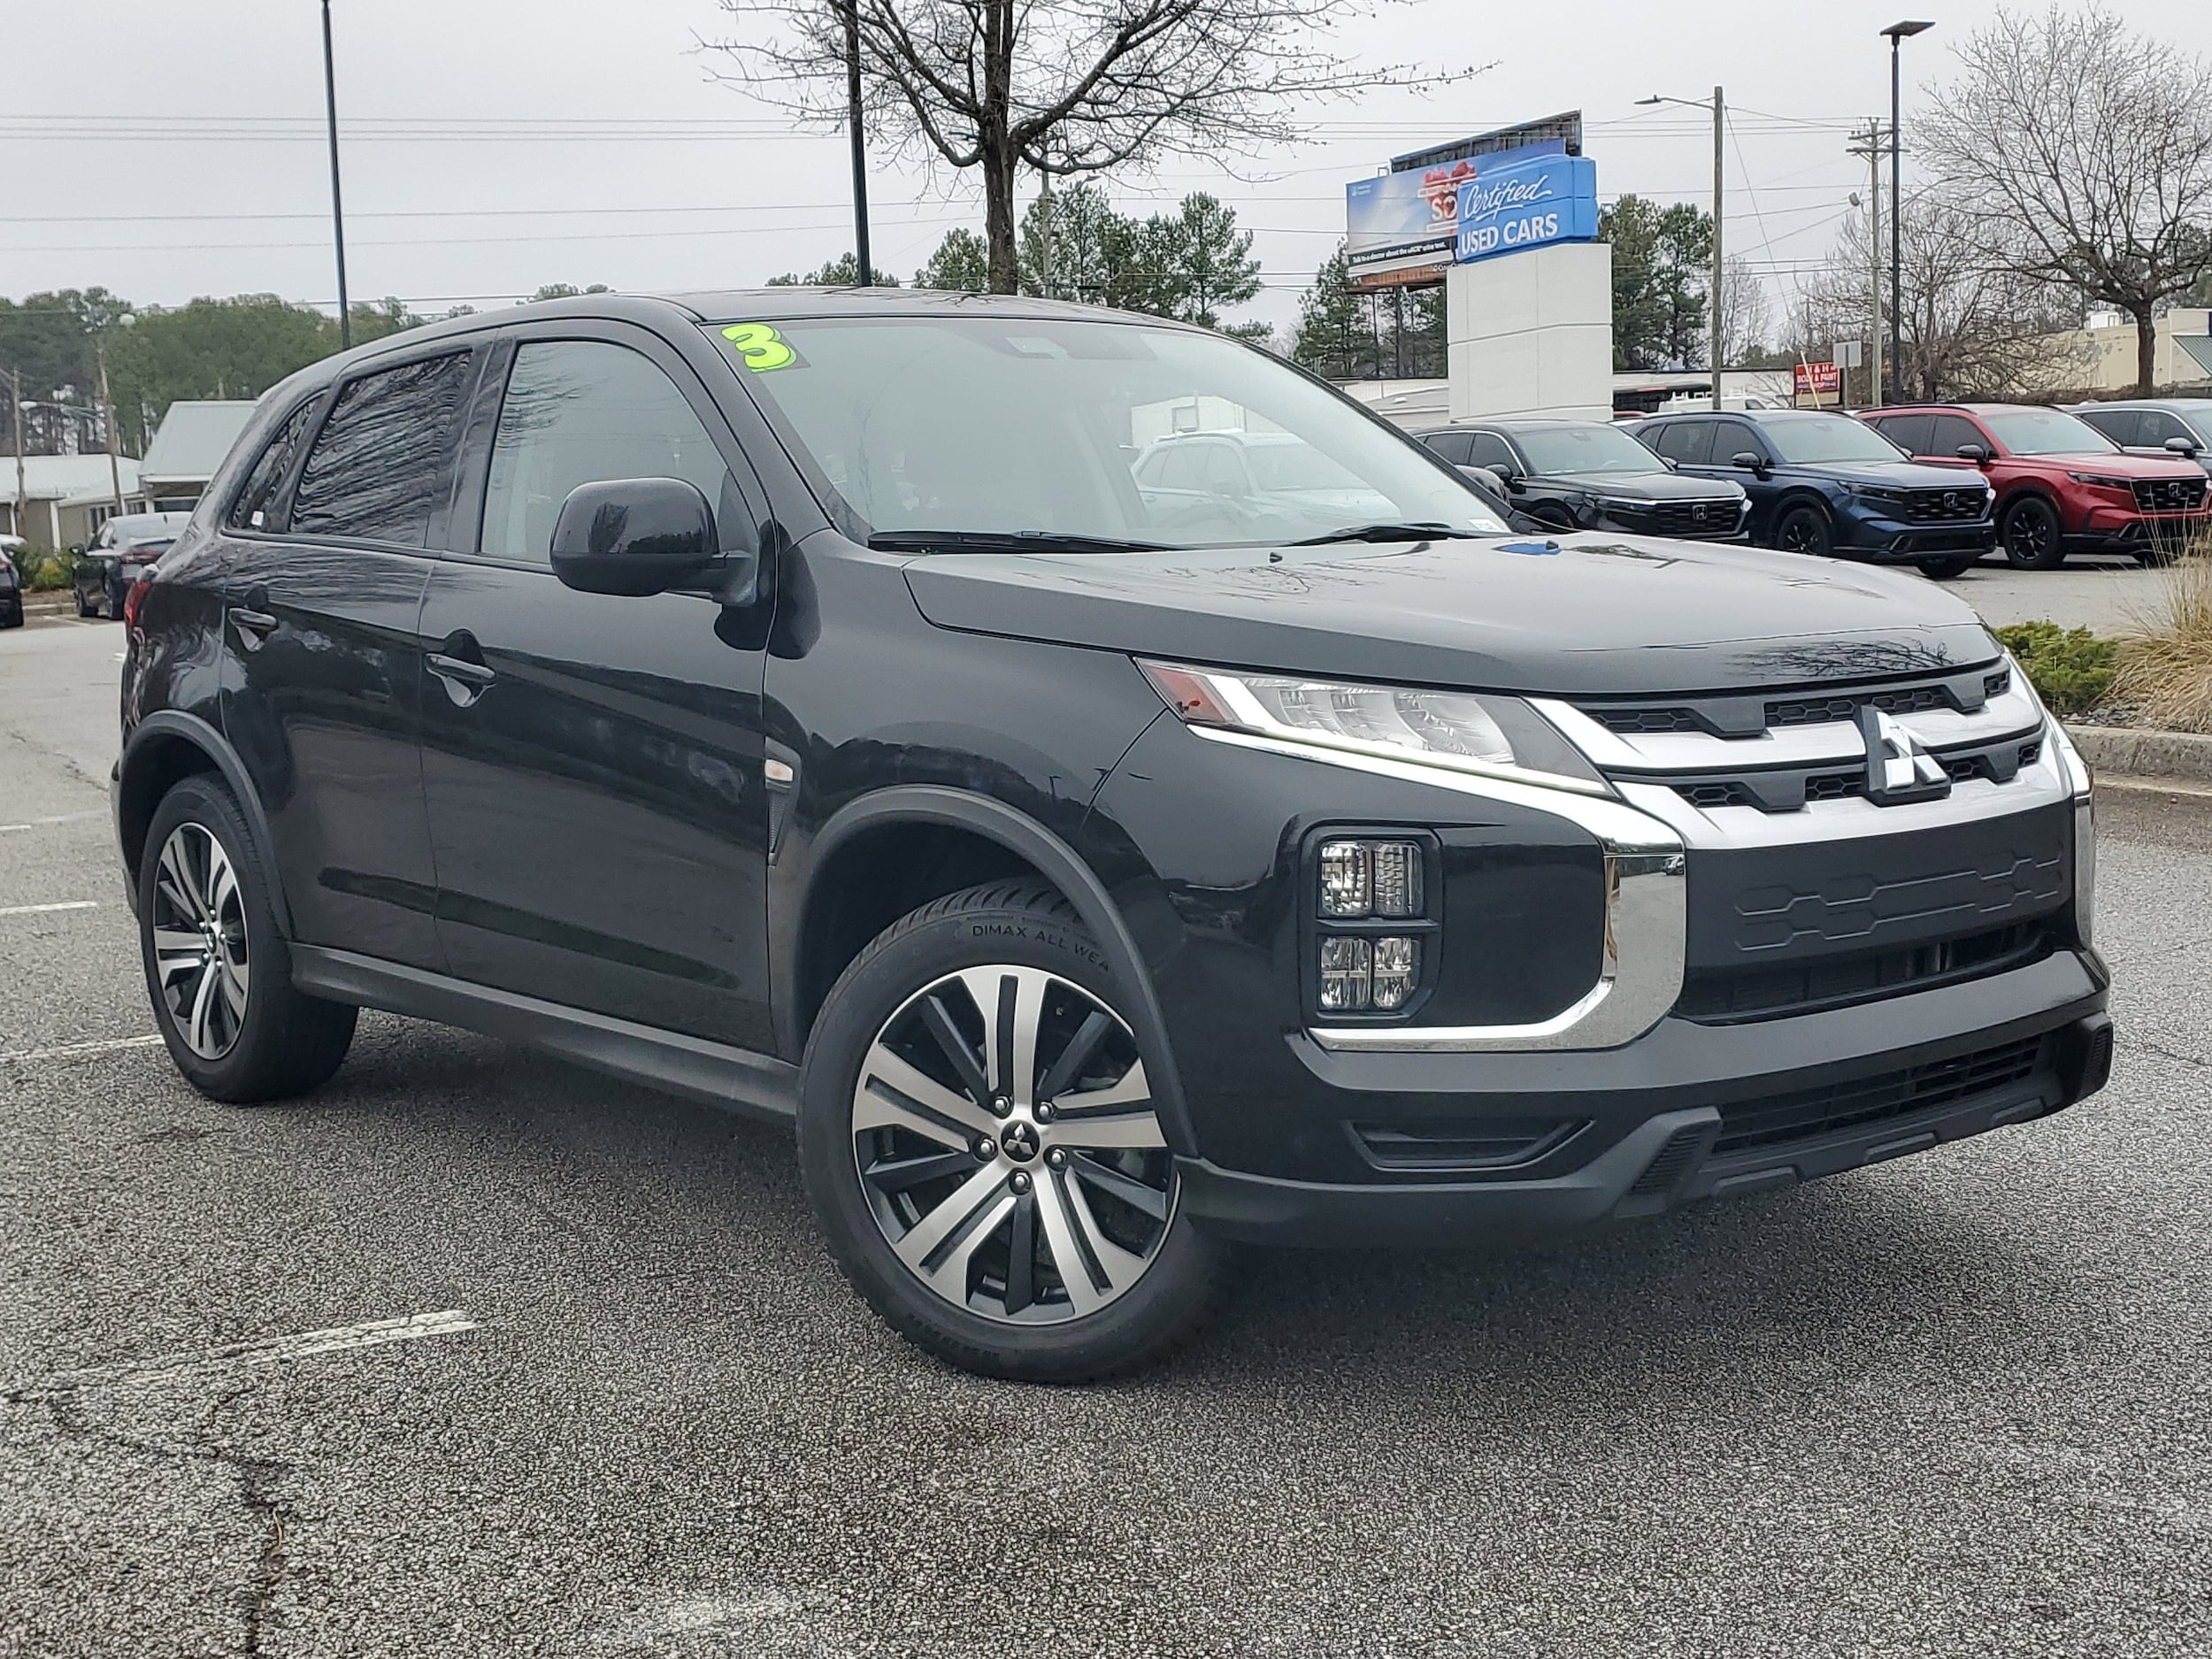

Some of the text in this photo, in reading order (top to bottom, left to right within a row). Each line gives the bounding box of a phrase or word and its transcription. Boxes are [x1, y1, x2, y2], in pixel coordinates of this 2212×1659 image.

[1465, 175, 1552, 221] Certified
[1461, 213, 1558, 256] USED CARS
[721, 323, 796, 373] 3
[973, 925, 1027, 938] DIMAX
[1035, 931, 1067, 949] ALL
